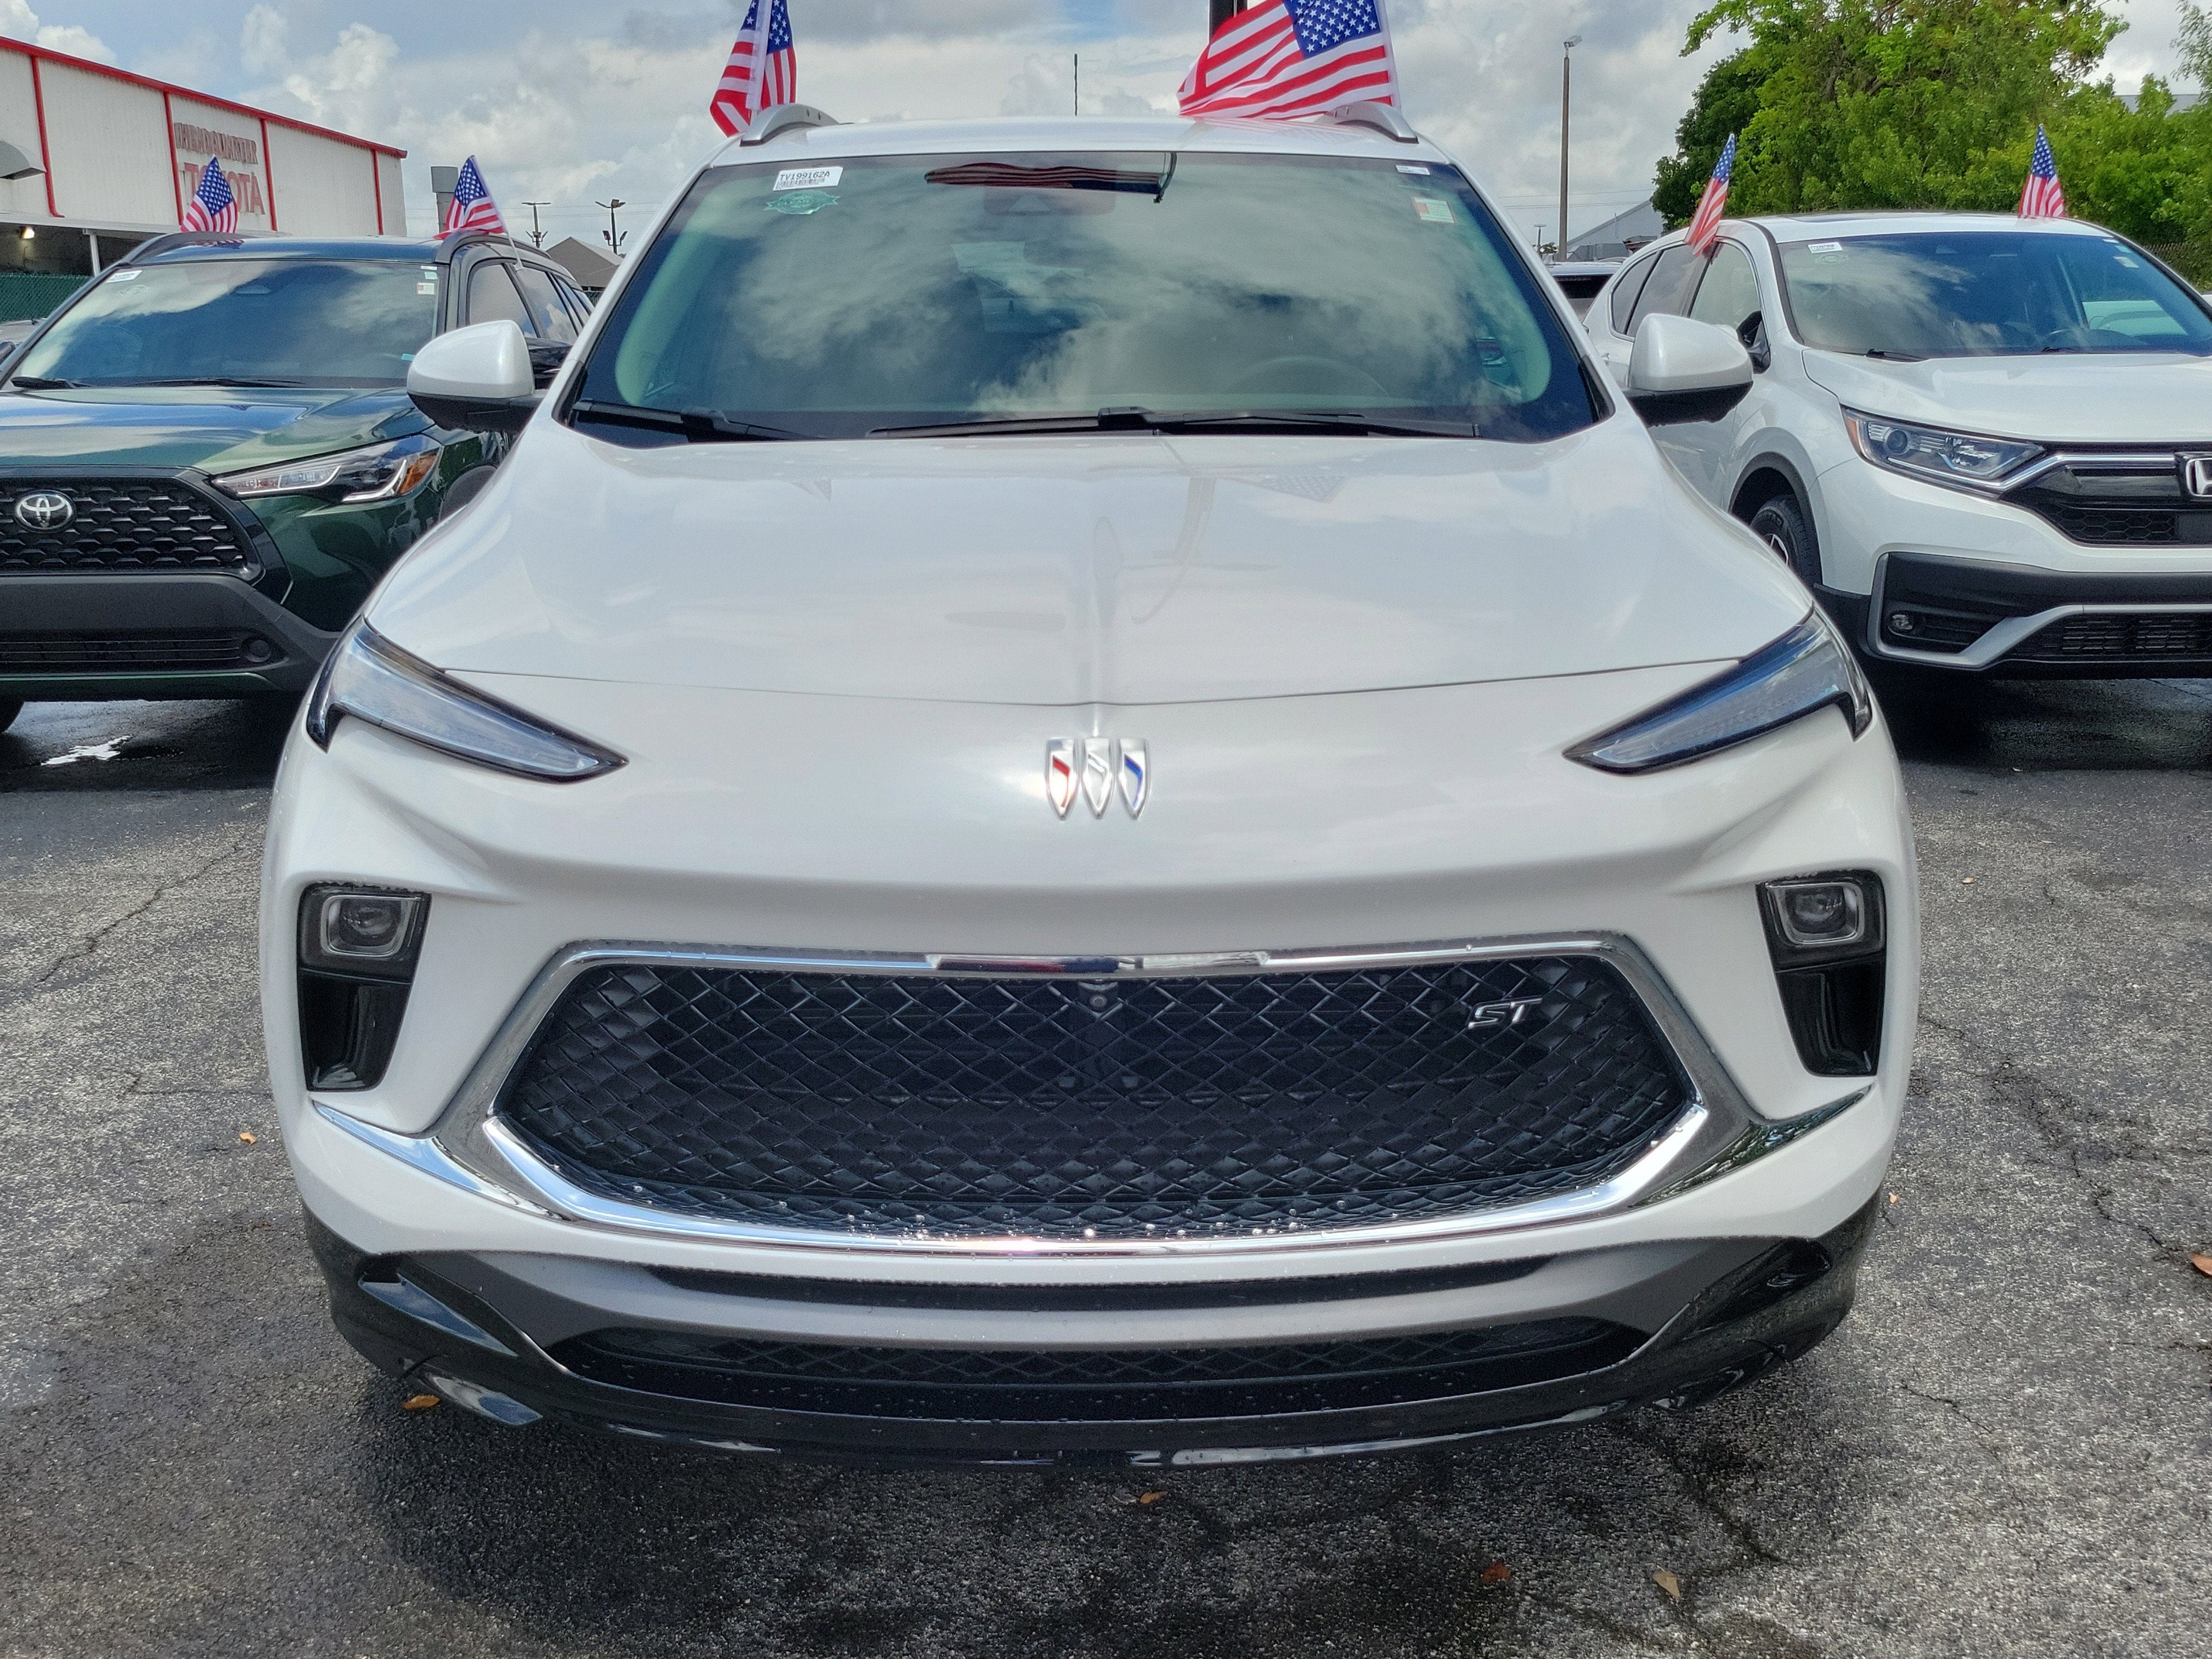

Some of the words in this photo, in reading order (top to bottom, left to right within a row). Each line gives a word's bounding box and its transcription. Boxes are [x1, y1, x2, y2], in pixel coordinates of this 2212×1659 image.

[179, 162, 266, 215] TOTA
[780, 171, 831, 181] TV199162A
[1467, 997, 1543, 1030] ST
